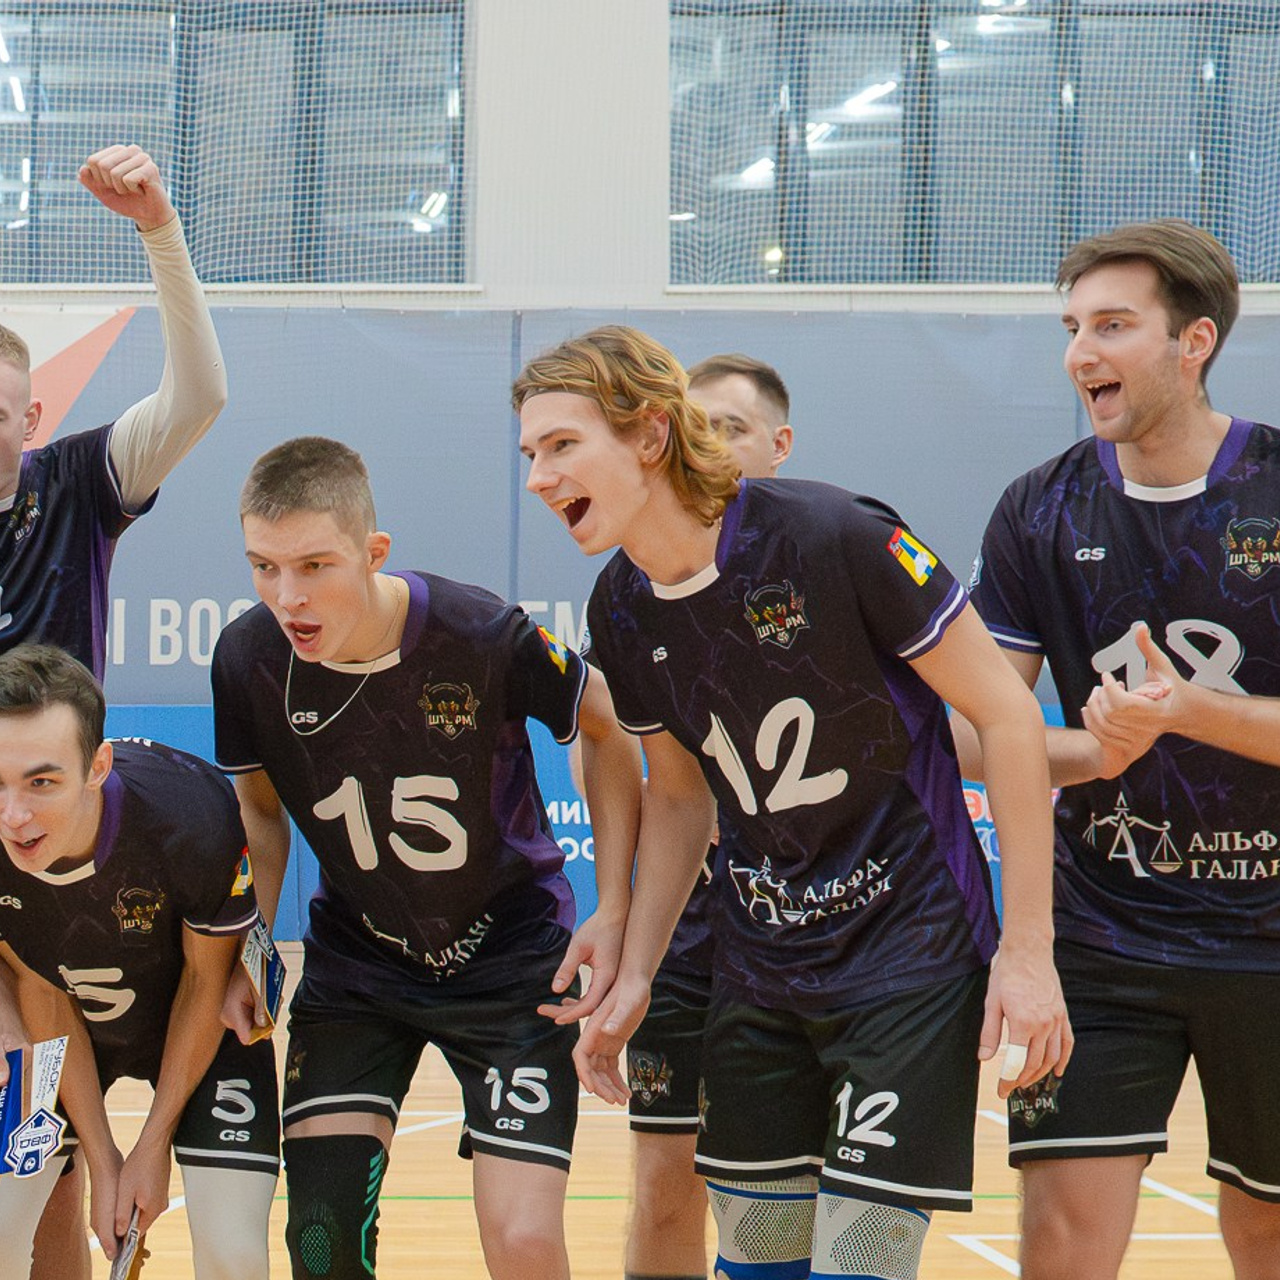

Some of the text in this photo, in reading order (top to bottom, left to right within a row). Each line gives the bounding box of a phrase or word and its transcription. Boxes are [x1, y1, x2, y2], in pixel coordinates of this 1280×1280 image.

[1074, 547, 1106, 562] GS
[290, 710, 319, 726] GS
[700, 696, 849, 816] 12
[312, 774, 469, 872] 15
[1188, 830, 1280, 853] АЛЬФ
[57, 964, 136, 1023] 5
[211, 1078, 257, 1125] 5
[485, 1067, 551, 1115] 15
[494, 1117, 526, 1132] GS
[834, 1081, 901, 1149] 12
[219, 1128, 251, 1143] GS
[836, 1146, 867, 1164] GS
